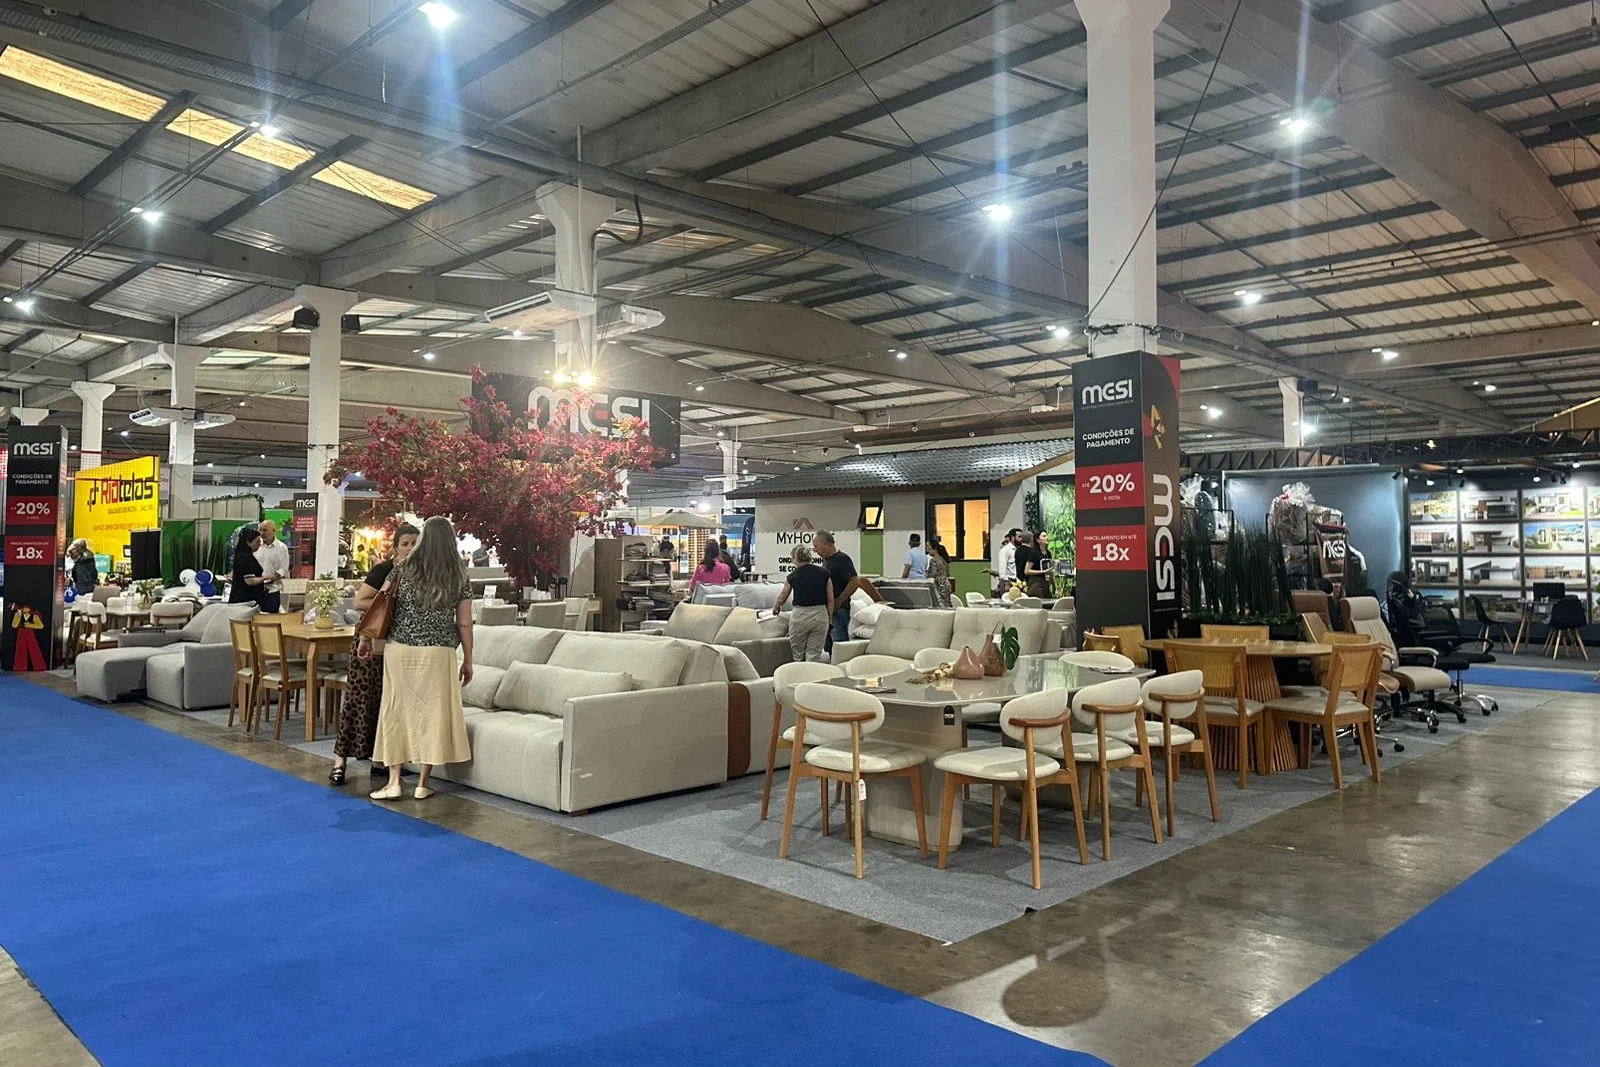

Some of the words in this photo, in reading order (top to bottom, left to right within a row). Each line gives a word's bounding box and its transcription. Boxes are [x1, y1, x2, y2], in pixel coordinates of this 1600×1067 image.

[1082, 429, 1123, 441] CONDIÇÕES
[1086, 437, 1130, 449] PAGAMENTO
[1089, 473, 1135, 493] 20%
[16, 502, 50, 515] 20%
[16, 547, 43, 559] 18x
[1092, 543, 1130, 562] 18x
